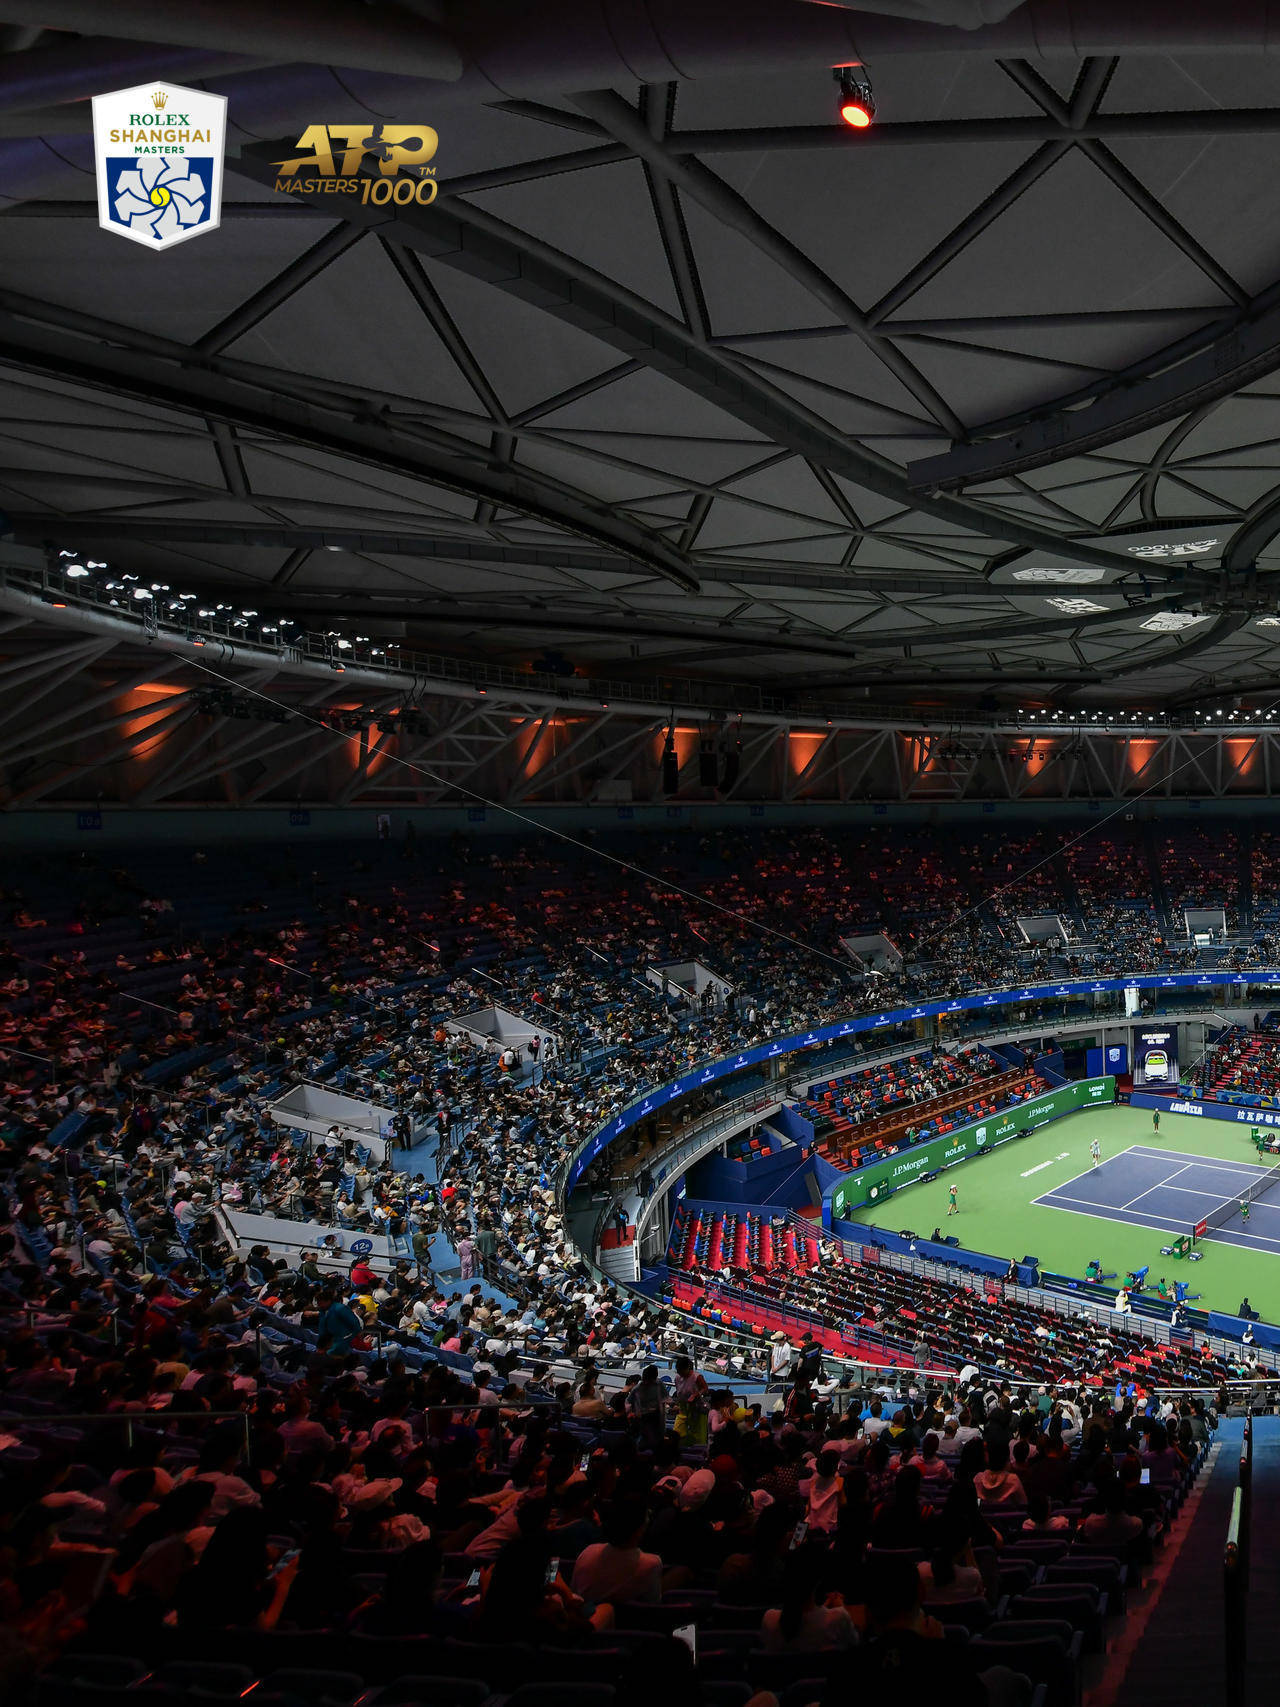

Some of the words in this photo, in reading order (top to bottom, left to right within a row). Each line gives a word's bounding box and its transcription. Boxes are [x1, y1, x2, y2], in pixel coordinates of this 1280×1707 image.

[1170, 1102, 1203, 1115] LAVAZZA
[995, 1122, 1016, 1136] ROLEX
[944, 1144, 967, 1159] ROLEX
